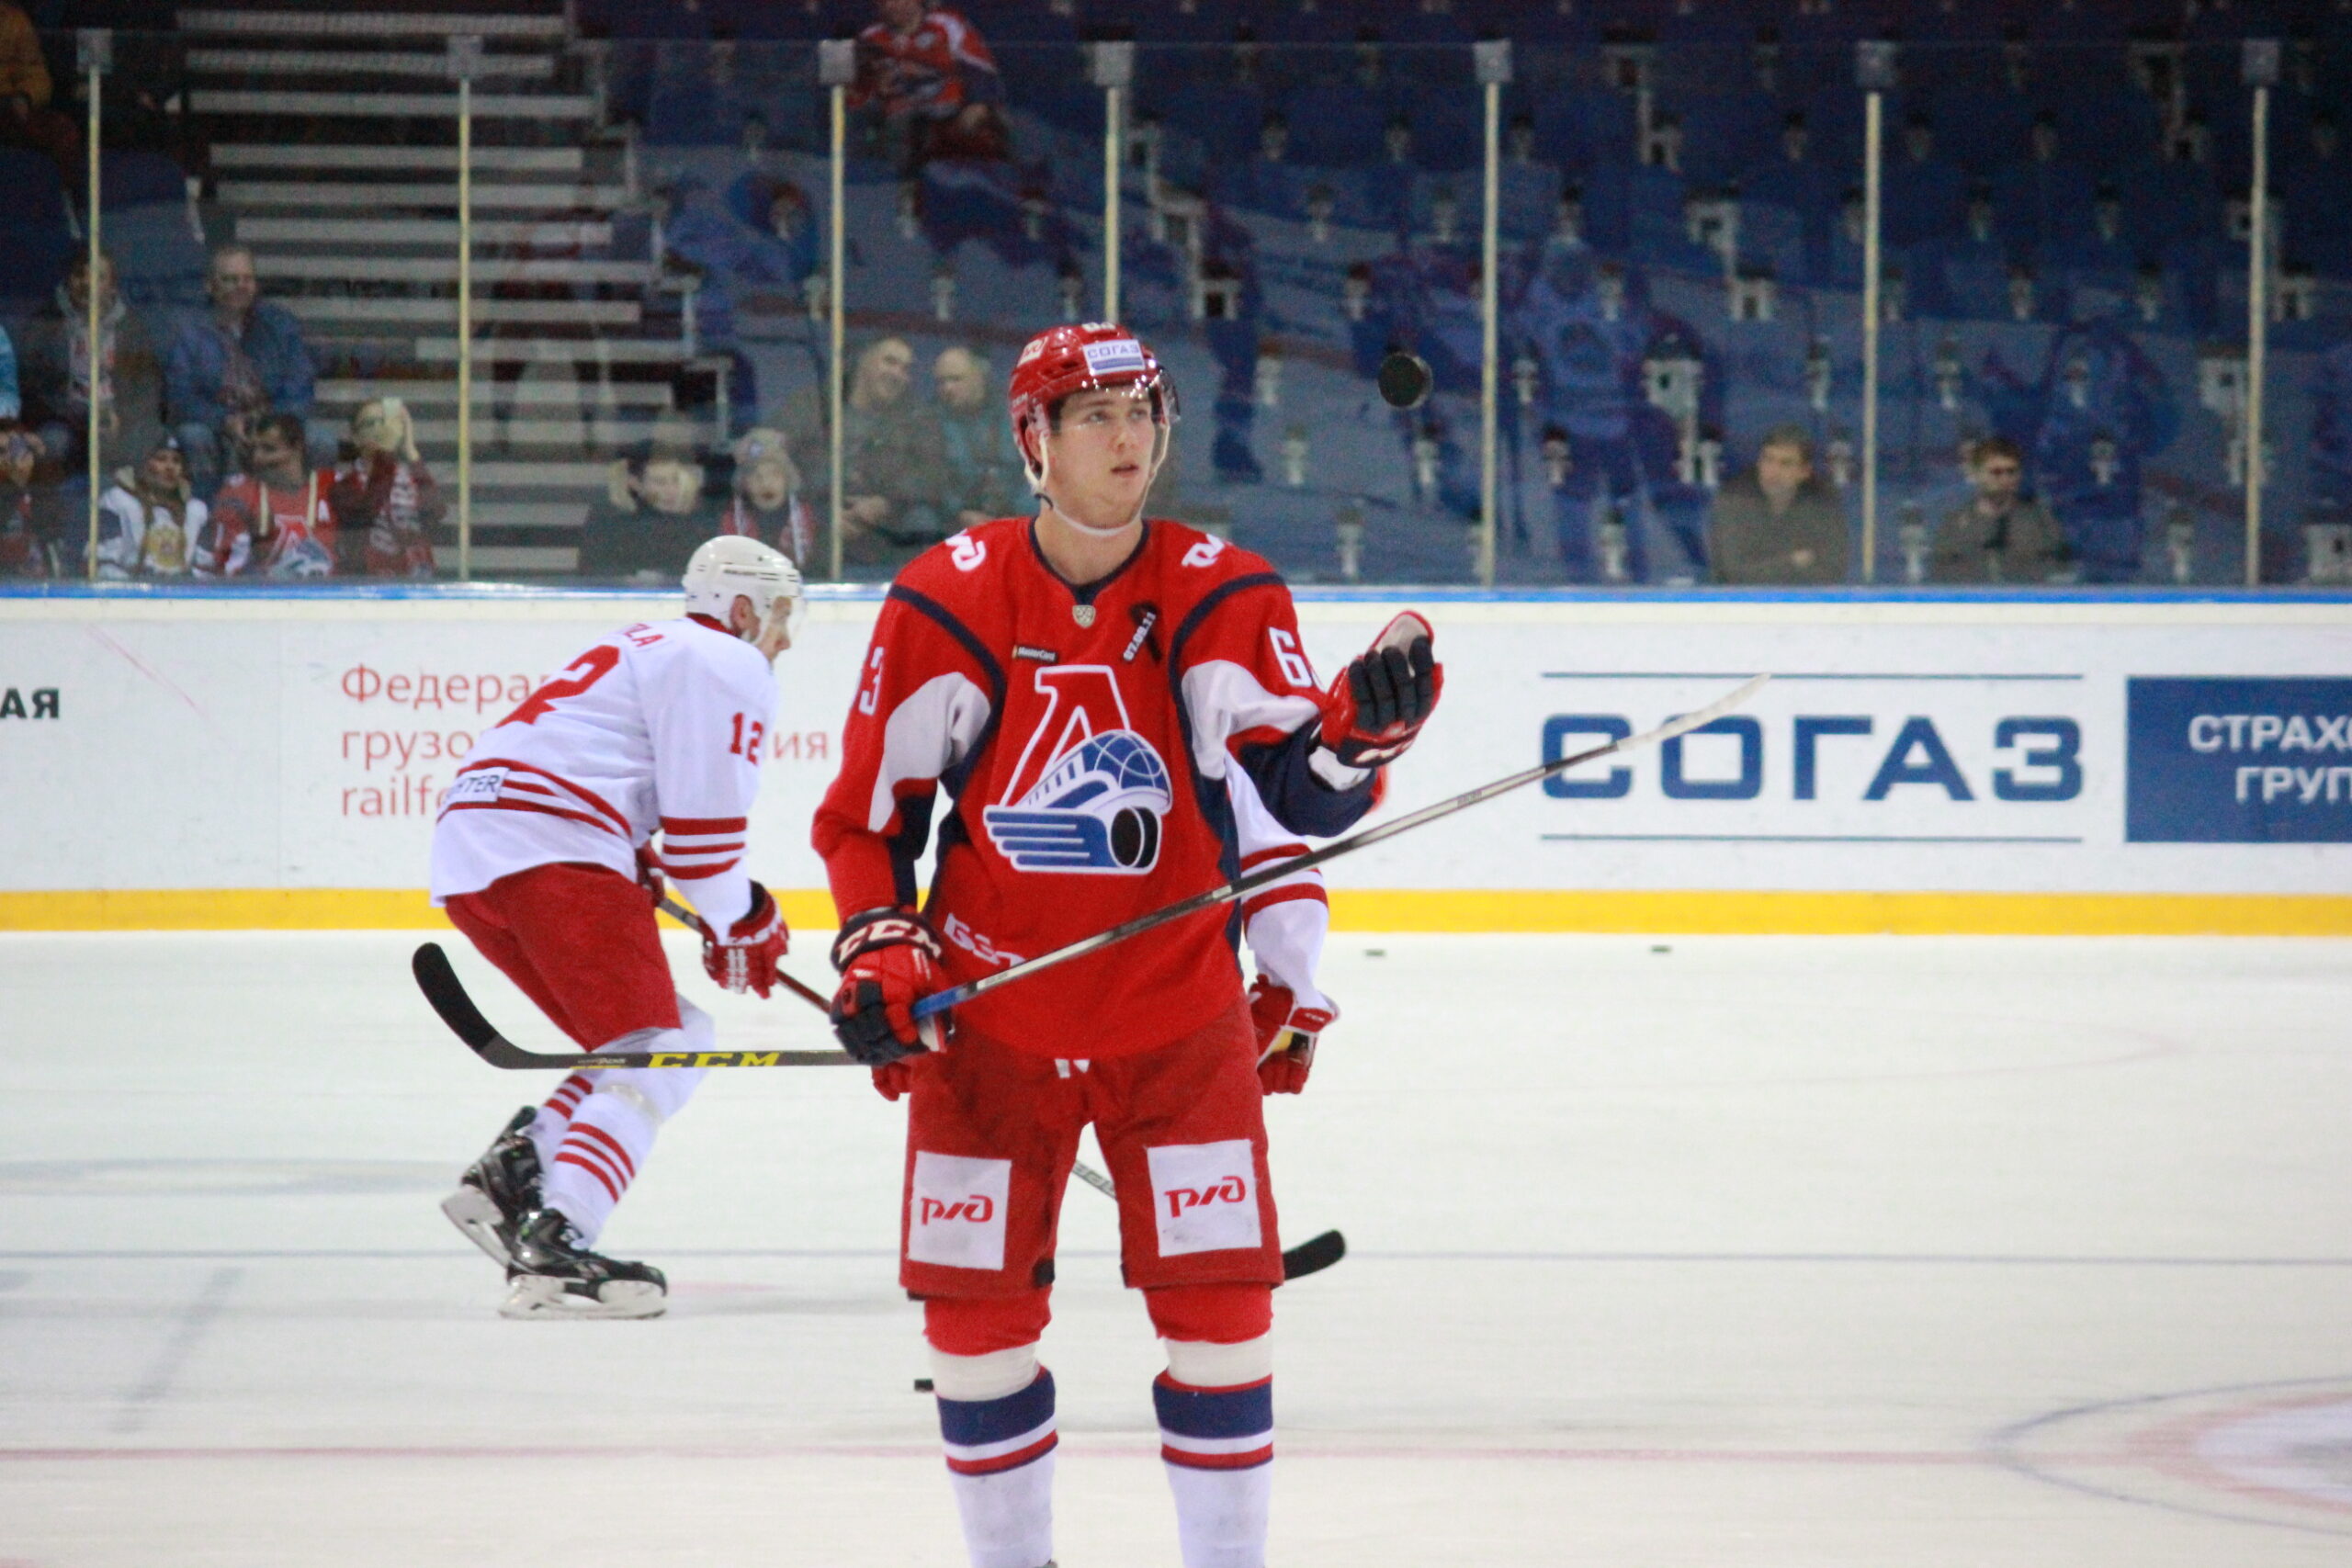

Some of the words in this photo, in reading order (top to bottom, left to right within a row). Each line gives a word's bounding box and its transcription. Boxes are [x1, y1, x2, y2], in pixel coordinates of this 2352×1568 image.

[1087, 343, 1140, 358] СОГАЗ
[341, 730, 476, 771] грузо
[773, 731, 829, 760] ия
[729, 712, 764, 766] 12
[2188, 715, 2352, 753] СТРАХ
[1542, 714, 2083, 802] СОГАЗ
[458, 774, 501, 794] TER
[2235, 766, 2352, 805] ГРУП
[647, 1052, 780, 1068] CCM
